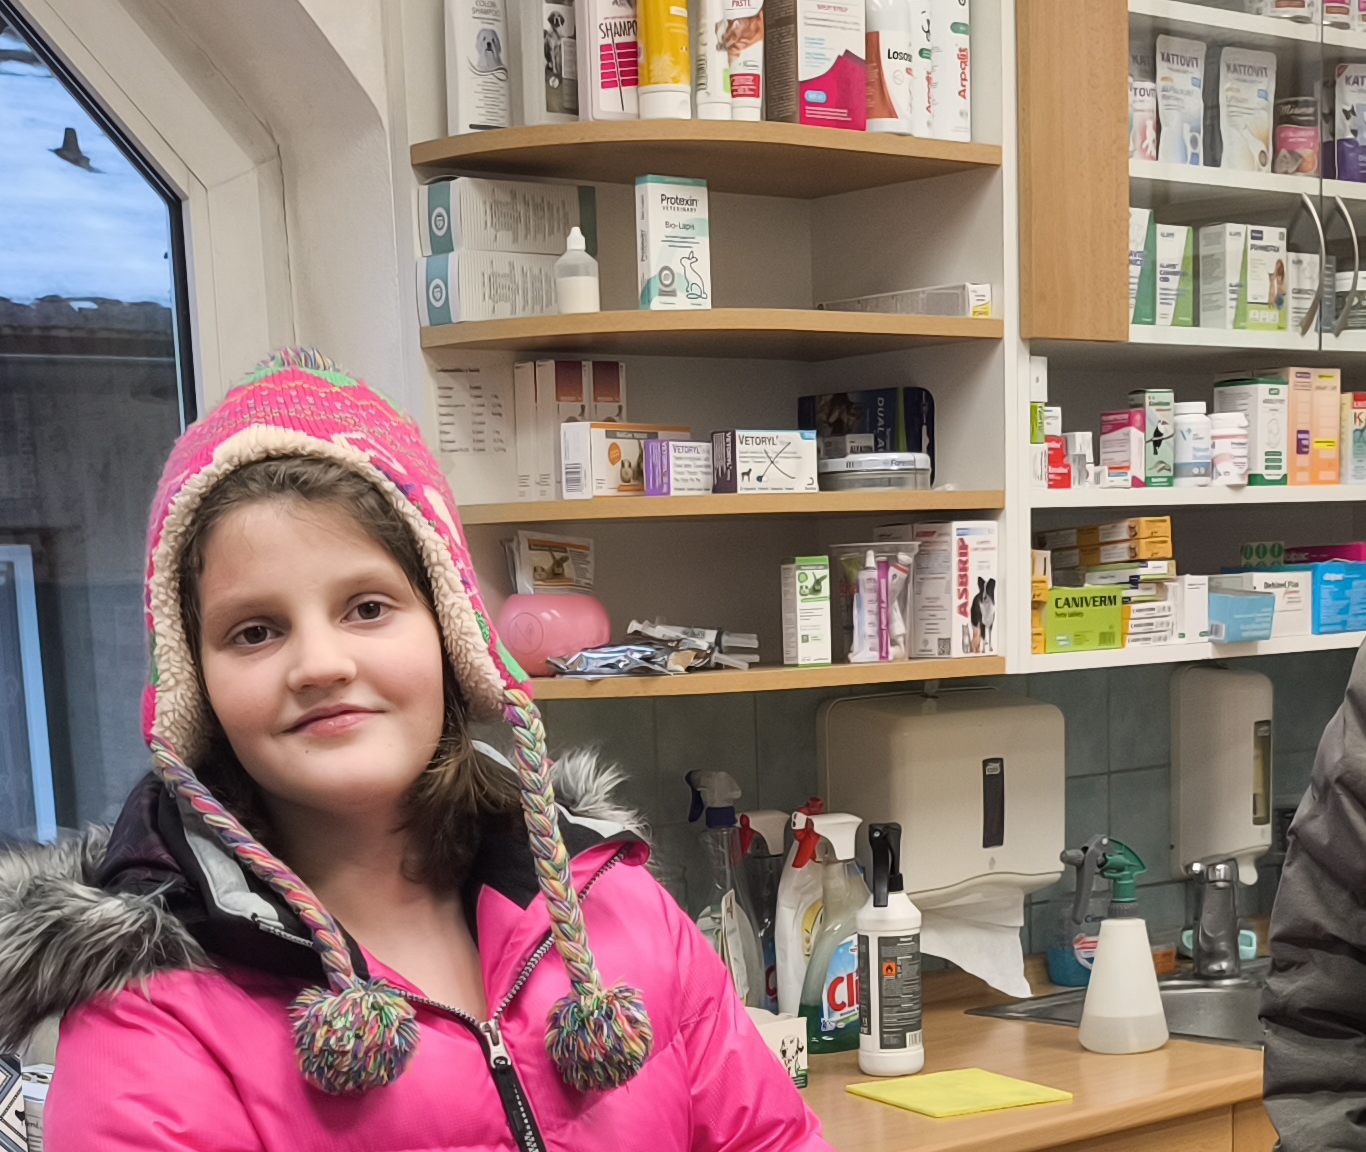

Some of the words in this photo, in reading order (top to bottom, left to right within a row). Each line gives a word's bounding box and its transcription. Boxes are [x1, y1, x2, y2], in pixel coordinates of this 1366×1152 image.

[1161, 52, 1199, 68] KATTOVIT
[1226, 62, 1268, 78] KATTOVIT
[660, 194, 698, 207] Protexin
[877, 397, 885, 434] DUAL
[738, 434, 777, 446] VETORYL
[1055, 595, 1117, 609] CANIVERM
